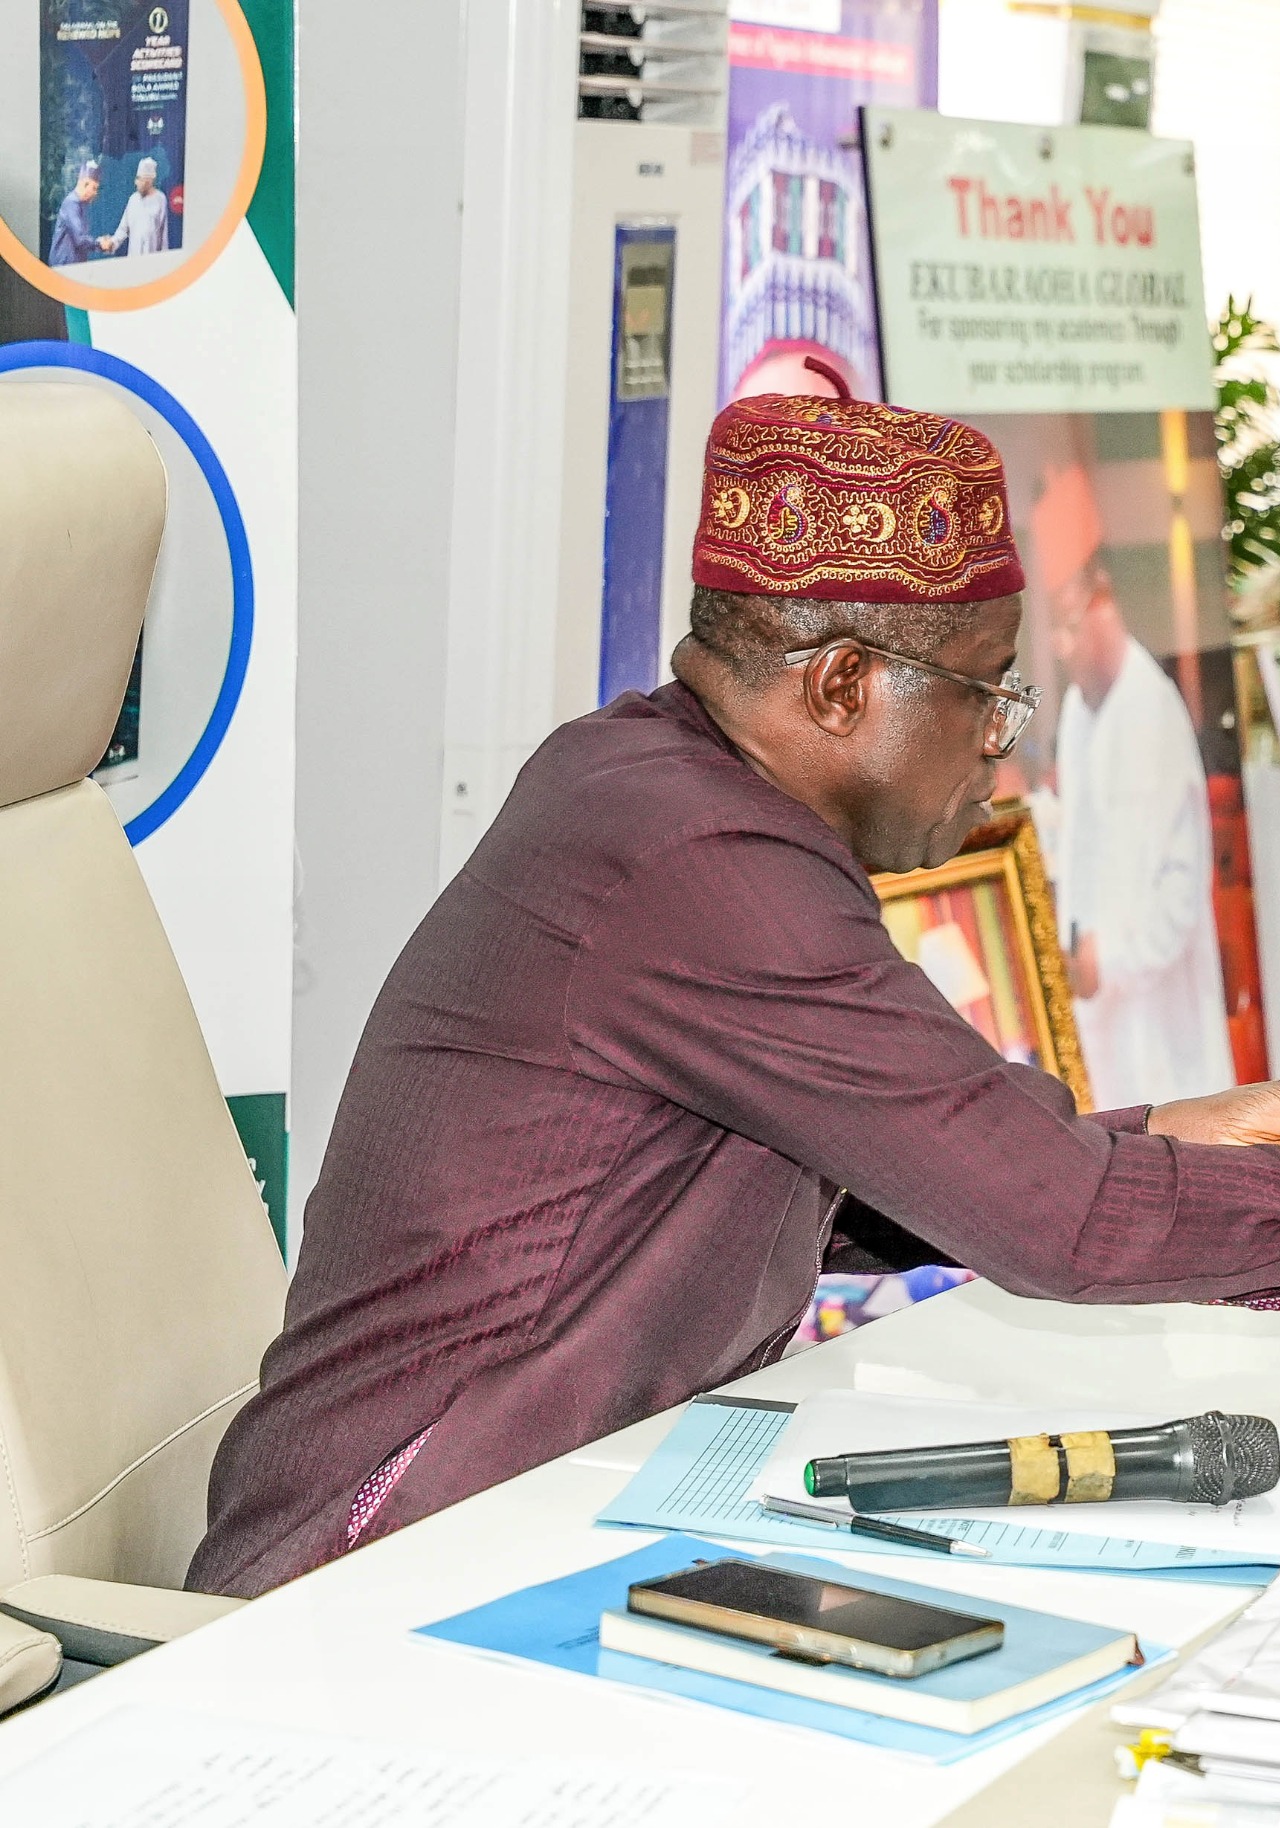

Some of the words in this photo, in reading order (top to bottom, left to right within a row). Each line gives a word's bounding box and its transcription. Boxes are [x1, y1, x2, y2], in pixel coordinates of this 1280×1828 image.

[145, 35, 171, 47] YEAR
[948, 177, 1075, 242] Thank
[1085, 186, 1156, 248] You
[917, 307, 942, 338] For
[949, 315, 1030, 347] sponsoring
